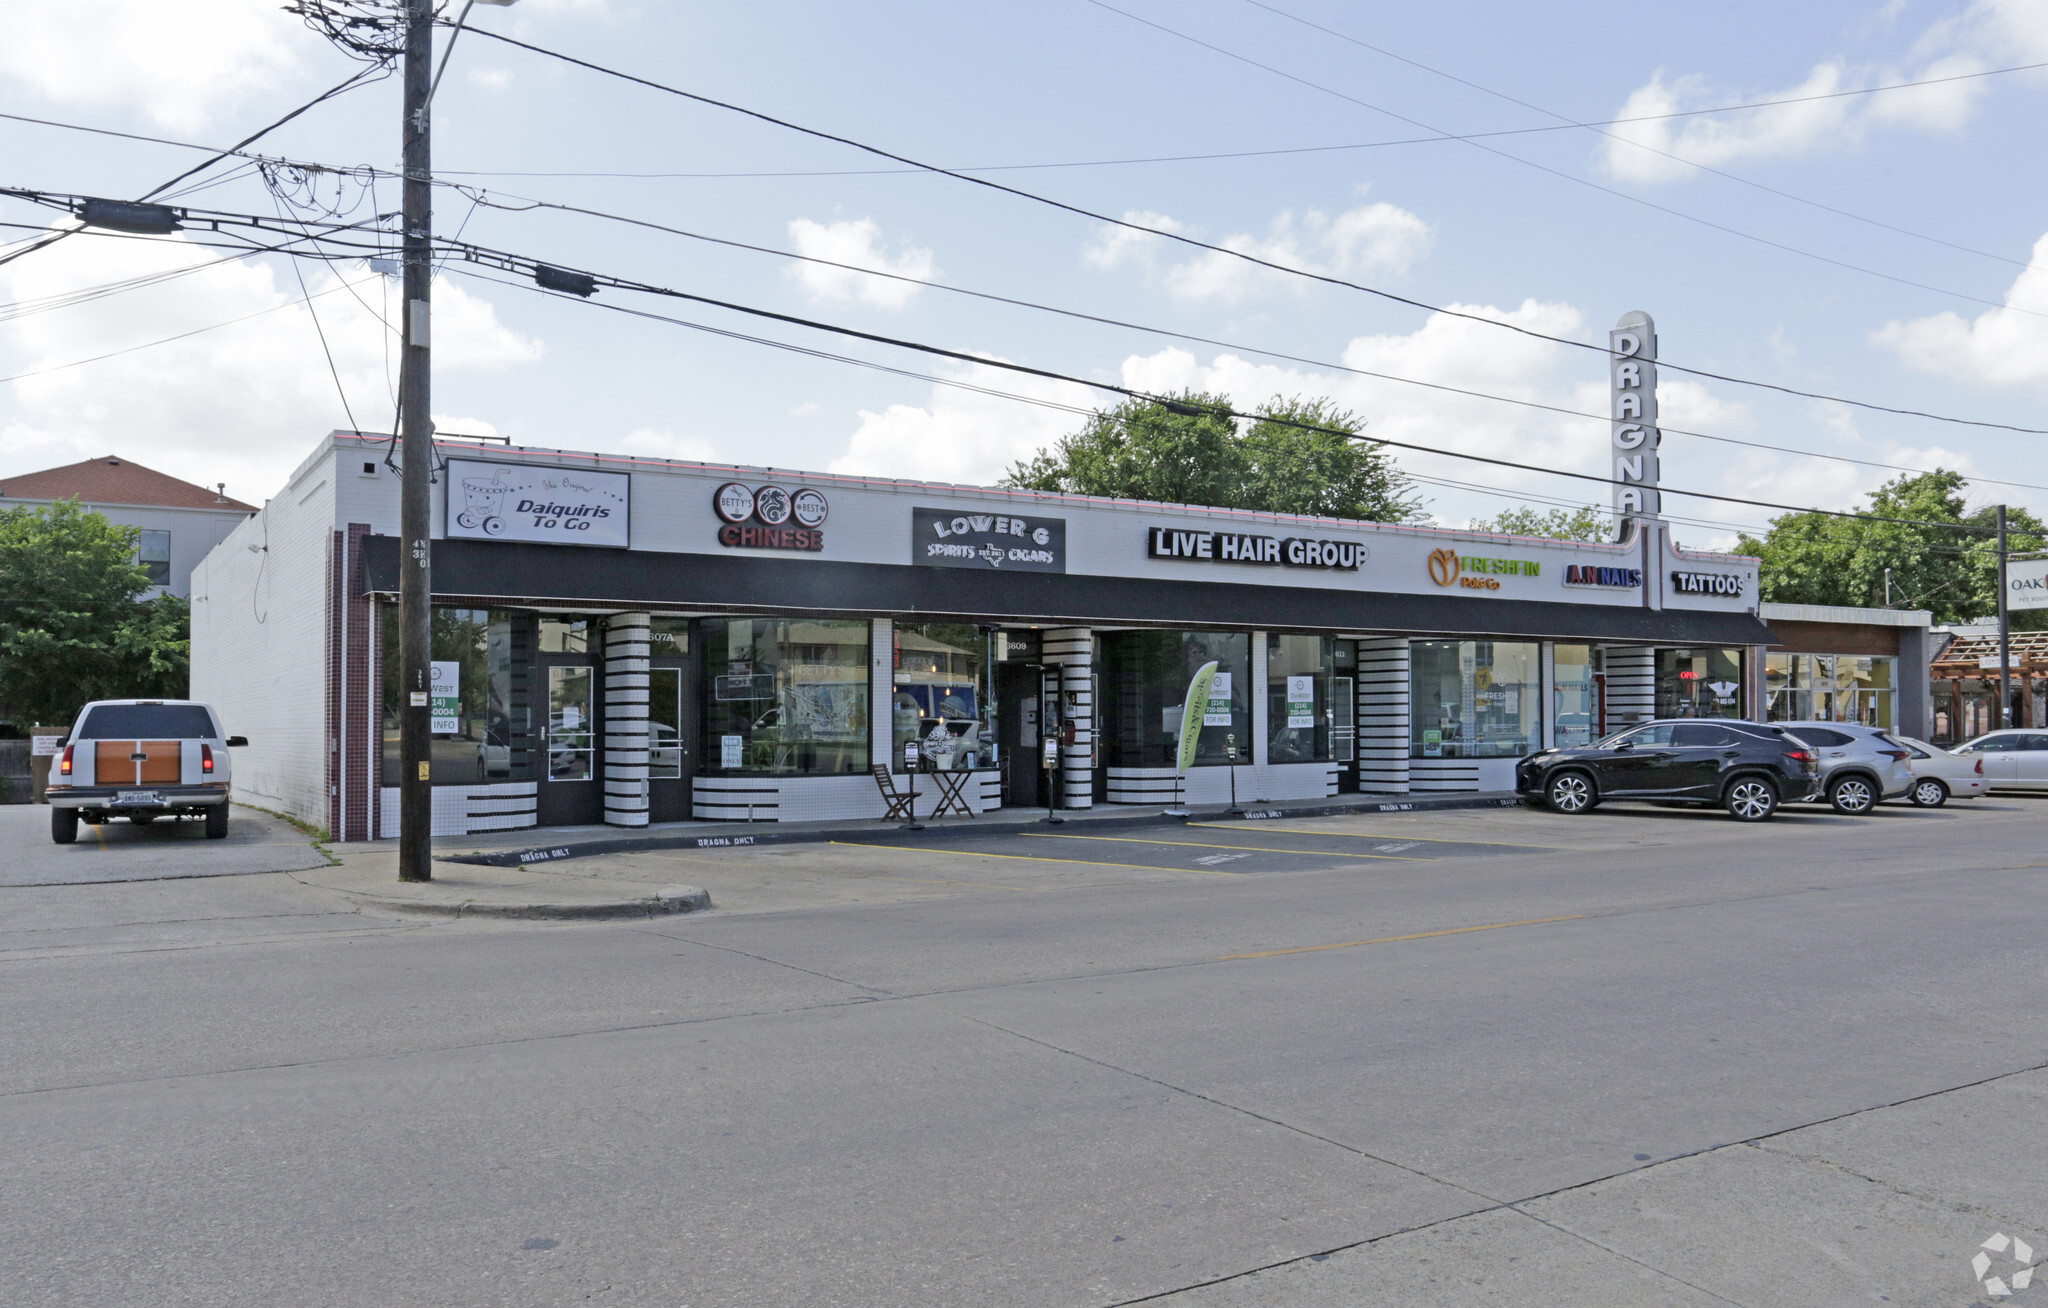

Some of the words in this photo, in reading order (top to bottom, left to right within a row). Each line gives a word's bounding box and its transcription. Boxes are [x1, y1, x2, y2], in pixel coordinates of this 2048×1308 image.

[1612, 332, 1647, 515] DRAGNA
[516, 499, 611, 518] Daiquiris
[721, 497, 752, 508] BETTY'S
[802, 503, 820, 513] BEST
[533, 515, 557, 529] To
[564, 517, 591, 531] Go
[933, 515, 1027, 539] LOWER
[1032, 527, 1050, 545] G
[723, 525, 824, 549] CHINESE
[927, 543, 976, 559] SPIRITS
[1008, 548, 1054, 564] CIGARS
[1156, 531, 1212, 558] LIVE
[1222, 535, 1281, 563] HAIR
[1288, 541, 1369, 568] GROUP
[1461, 556, 1541, 576] FRESHFIN
[1600, 566, 1642, 588] NAILS
[1678, 572, 1746, 595] TATTOOS
[2011, 578, 2044, 591] OAK
[1680, 671, 1699, 680] OPEN
[430, 685, 454, 693] WEST
[1485, 691, 1518, 700] FRESHFIN
[431, 698, 446, 706] 14)
[431, 708, 454, 716] -0004
[433, 720, 455, 730] INFO
[1290, 717, 1300, 725] FOR
[1300, 717, 1312, 725] INFO
[698, 838, 730, 846] DRAGNA
[734, 836, 754, 845] ONLY
[520, 850, 549, 862] DRAGNA
[552, 848, 569, 858] ONLY
